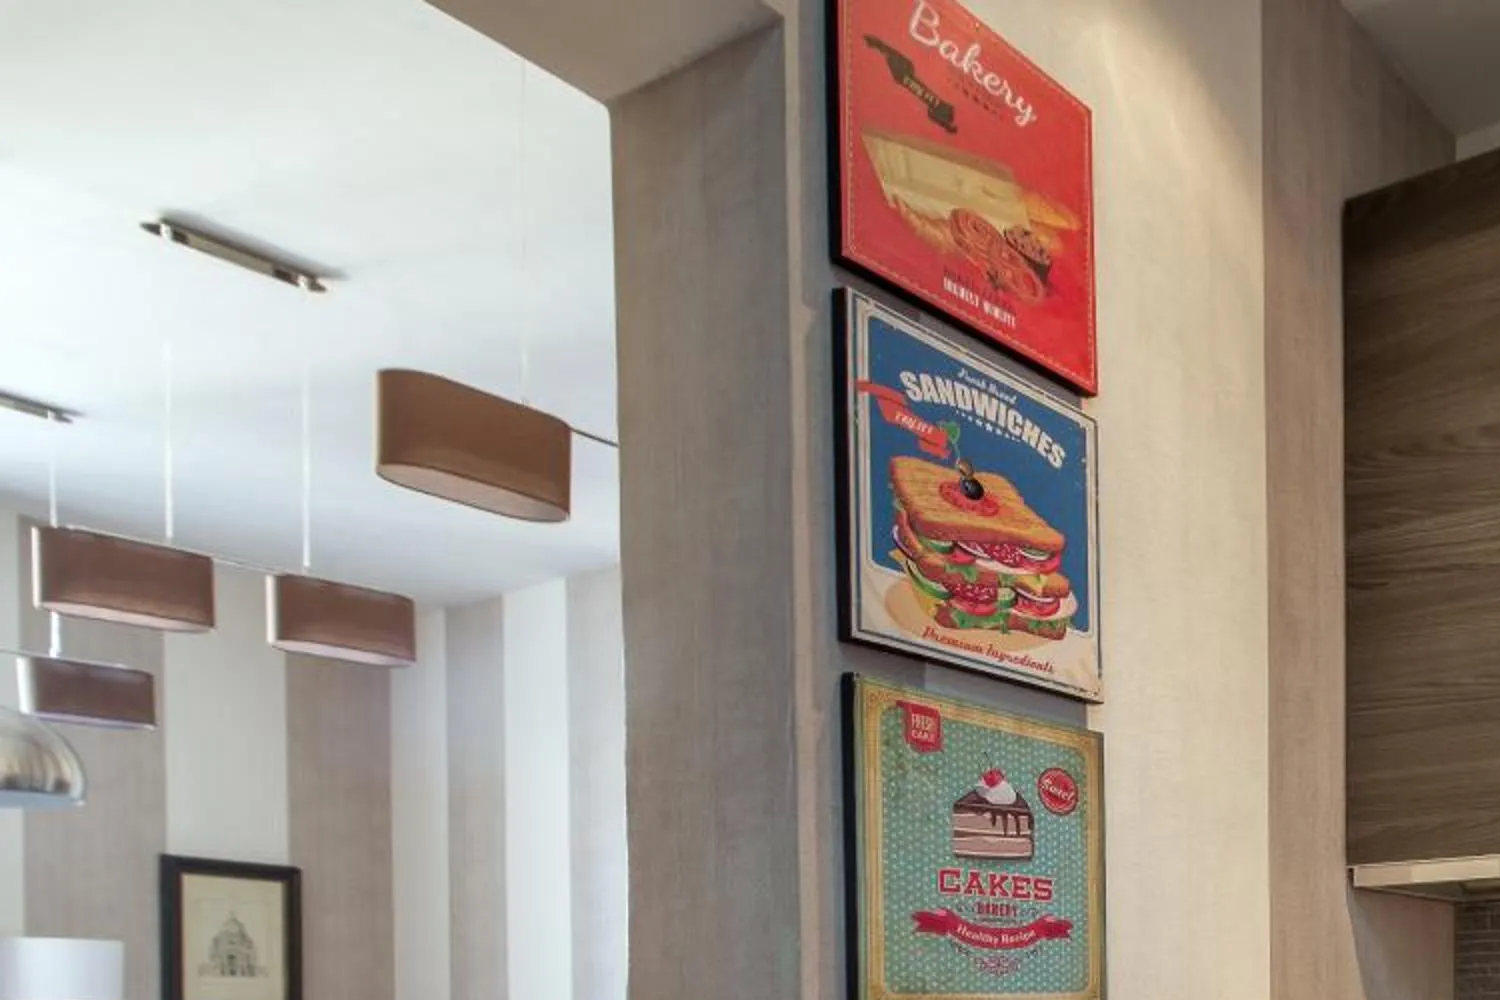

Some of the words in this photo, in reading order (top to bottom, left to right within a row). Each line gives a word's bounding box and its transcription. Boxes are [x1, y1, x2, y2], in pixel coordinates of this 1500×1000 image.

[909, 0, 1037, 127] Bakery
[899, 370, 1067, 469] SANDWICHES
[921, 625, 984, 655] Premium
[985, 643, 1055, 674] Ingredients
[938, 868, 1053, 901] CAKES
